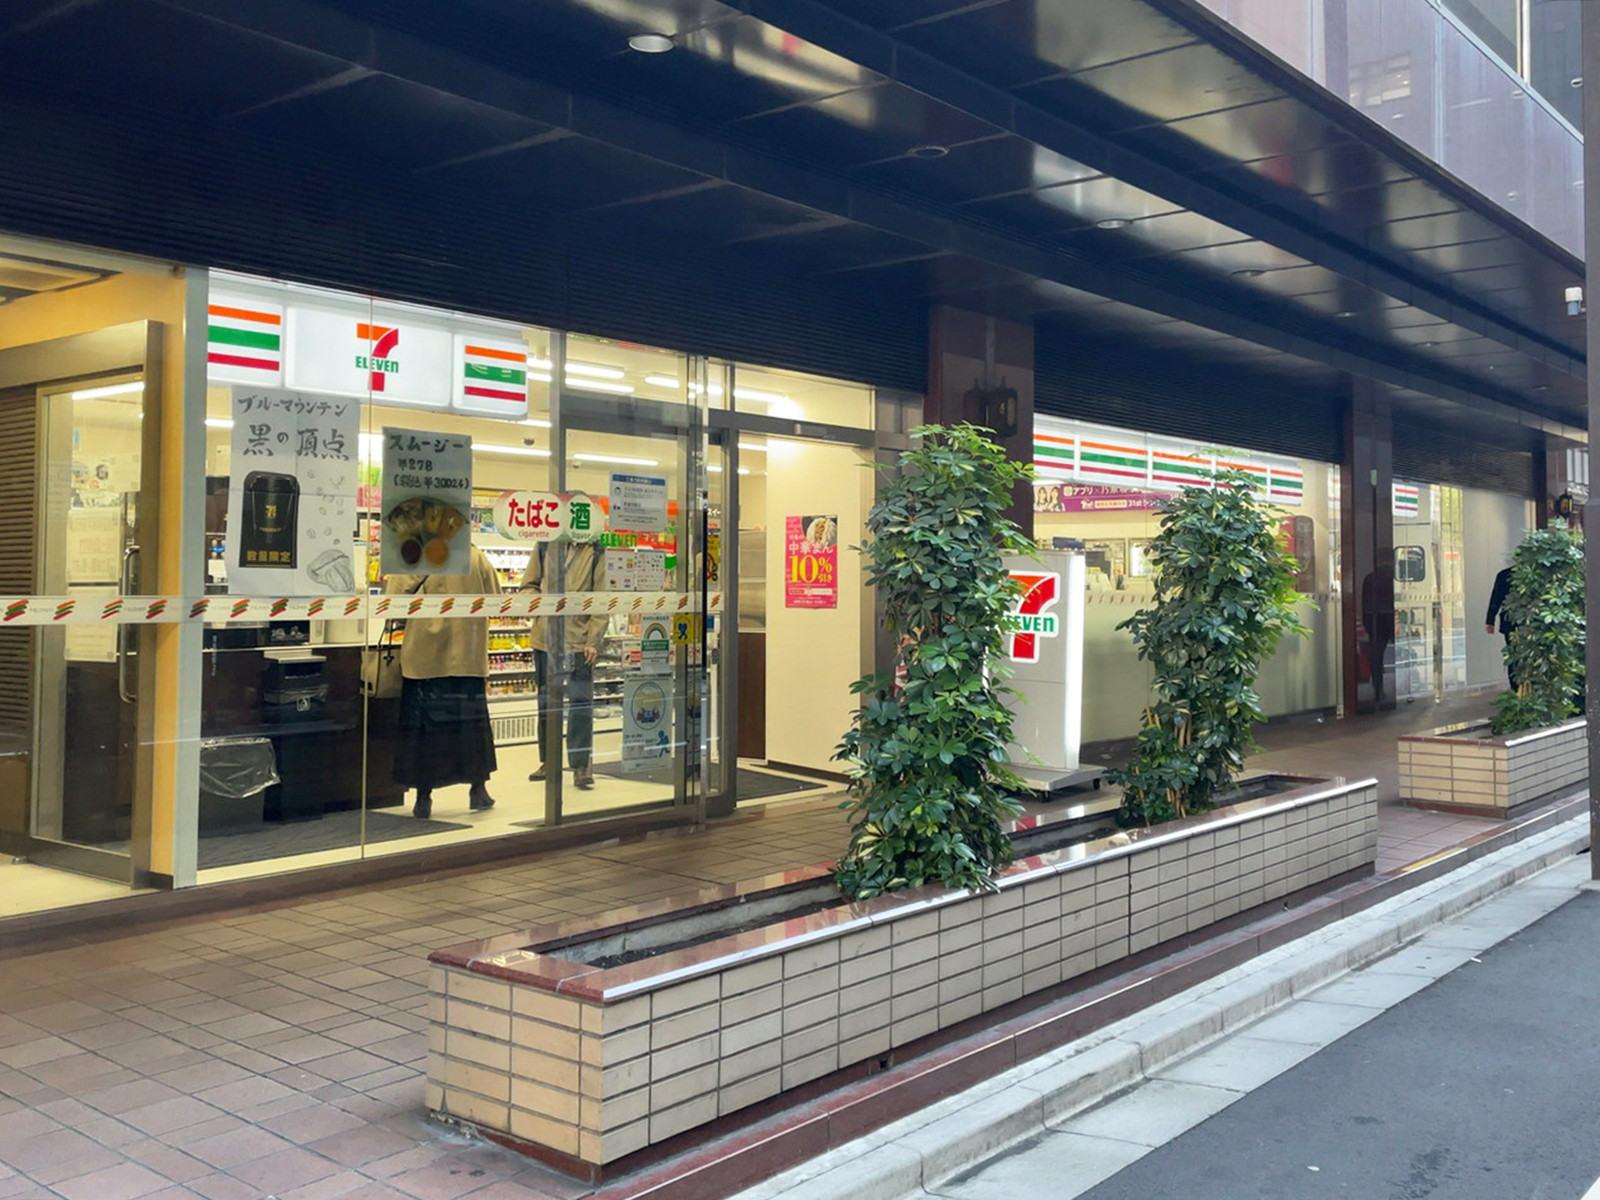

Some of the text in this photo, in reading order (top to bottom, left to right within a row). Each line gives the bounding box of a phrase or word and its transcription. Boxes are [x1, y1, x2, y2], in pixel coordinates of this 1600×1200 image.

[355, 356, 399, 373] ELEVEN
[356, 323, 399, 392] 7
[238, 394, 348, 416] ブルーマウンテン
[243, 423, 349, 461] 黒の頂点
[389, 434, 464, 453] スムージー
[508, 498, 560, 528] たばこ
[569, 501, 591, 530] 酒
[600, 532, 638, 548] ELEVEN
